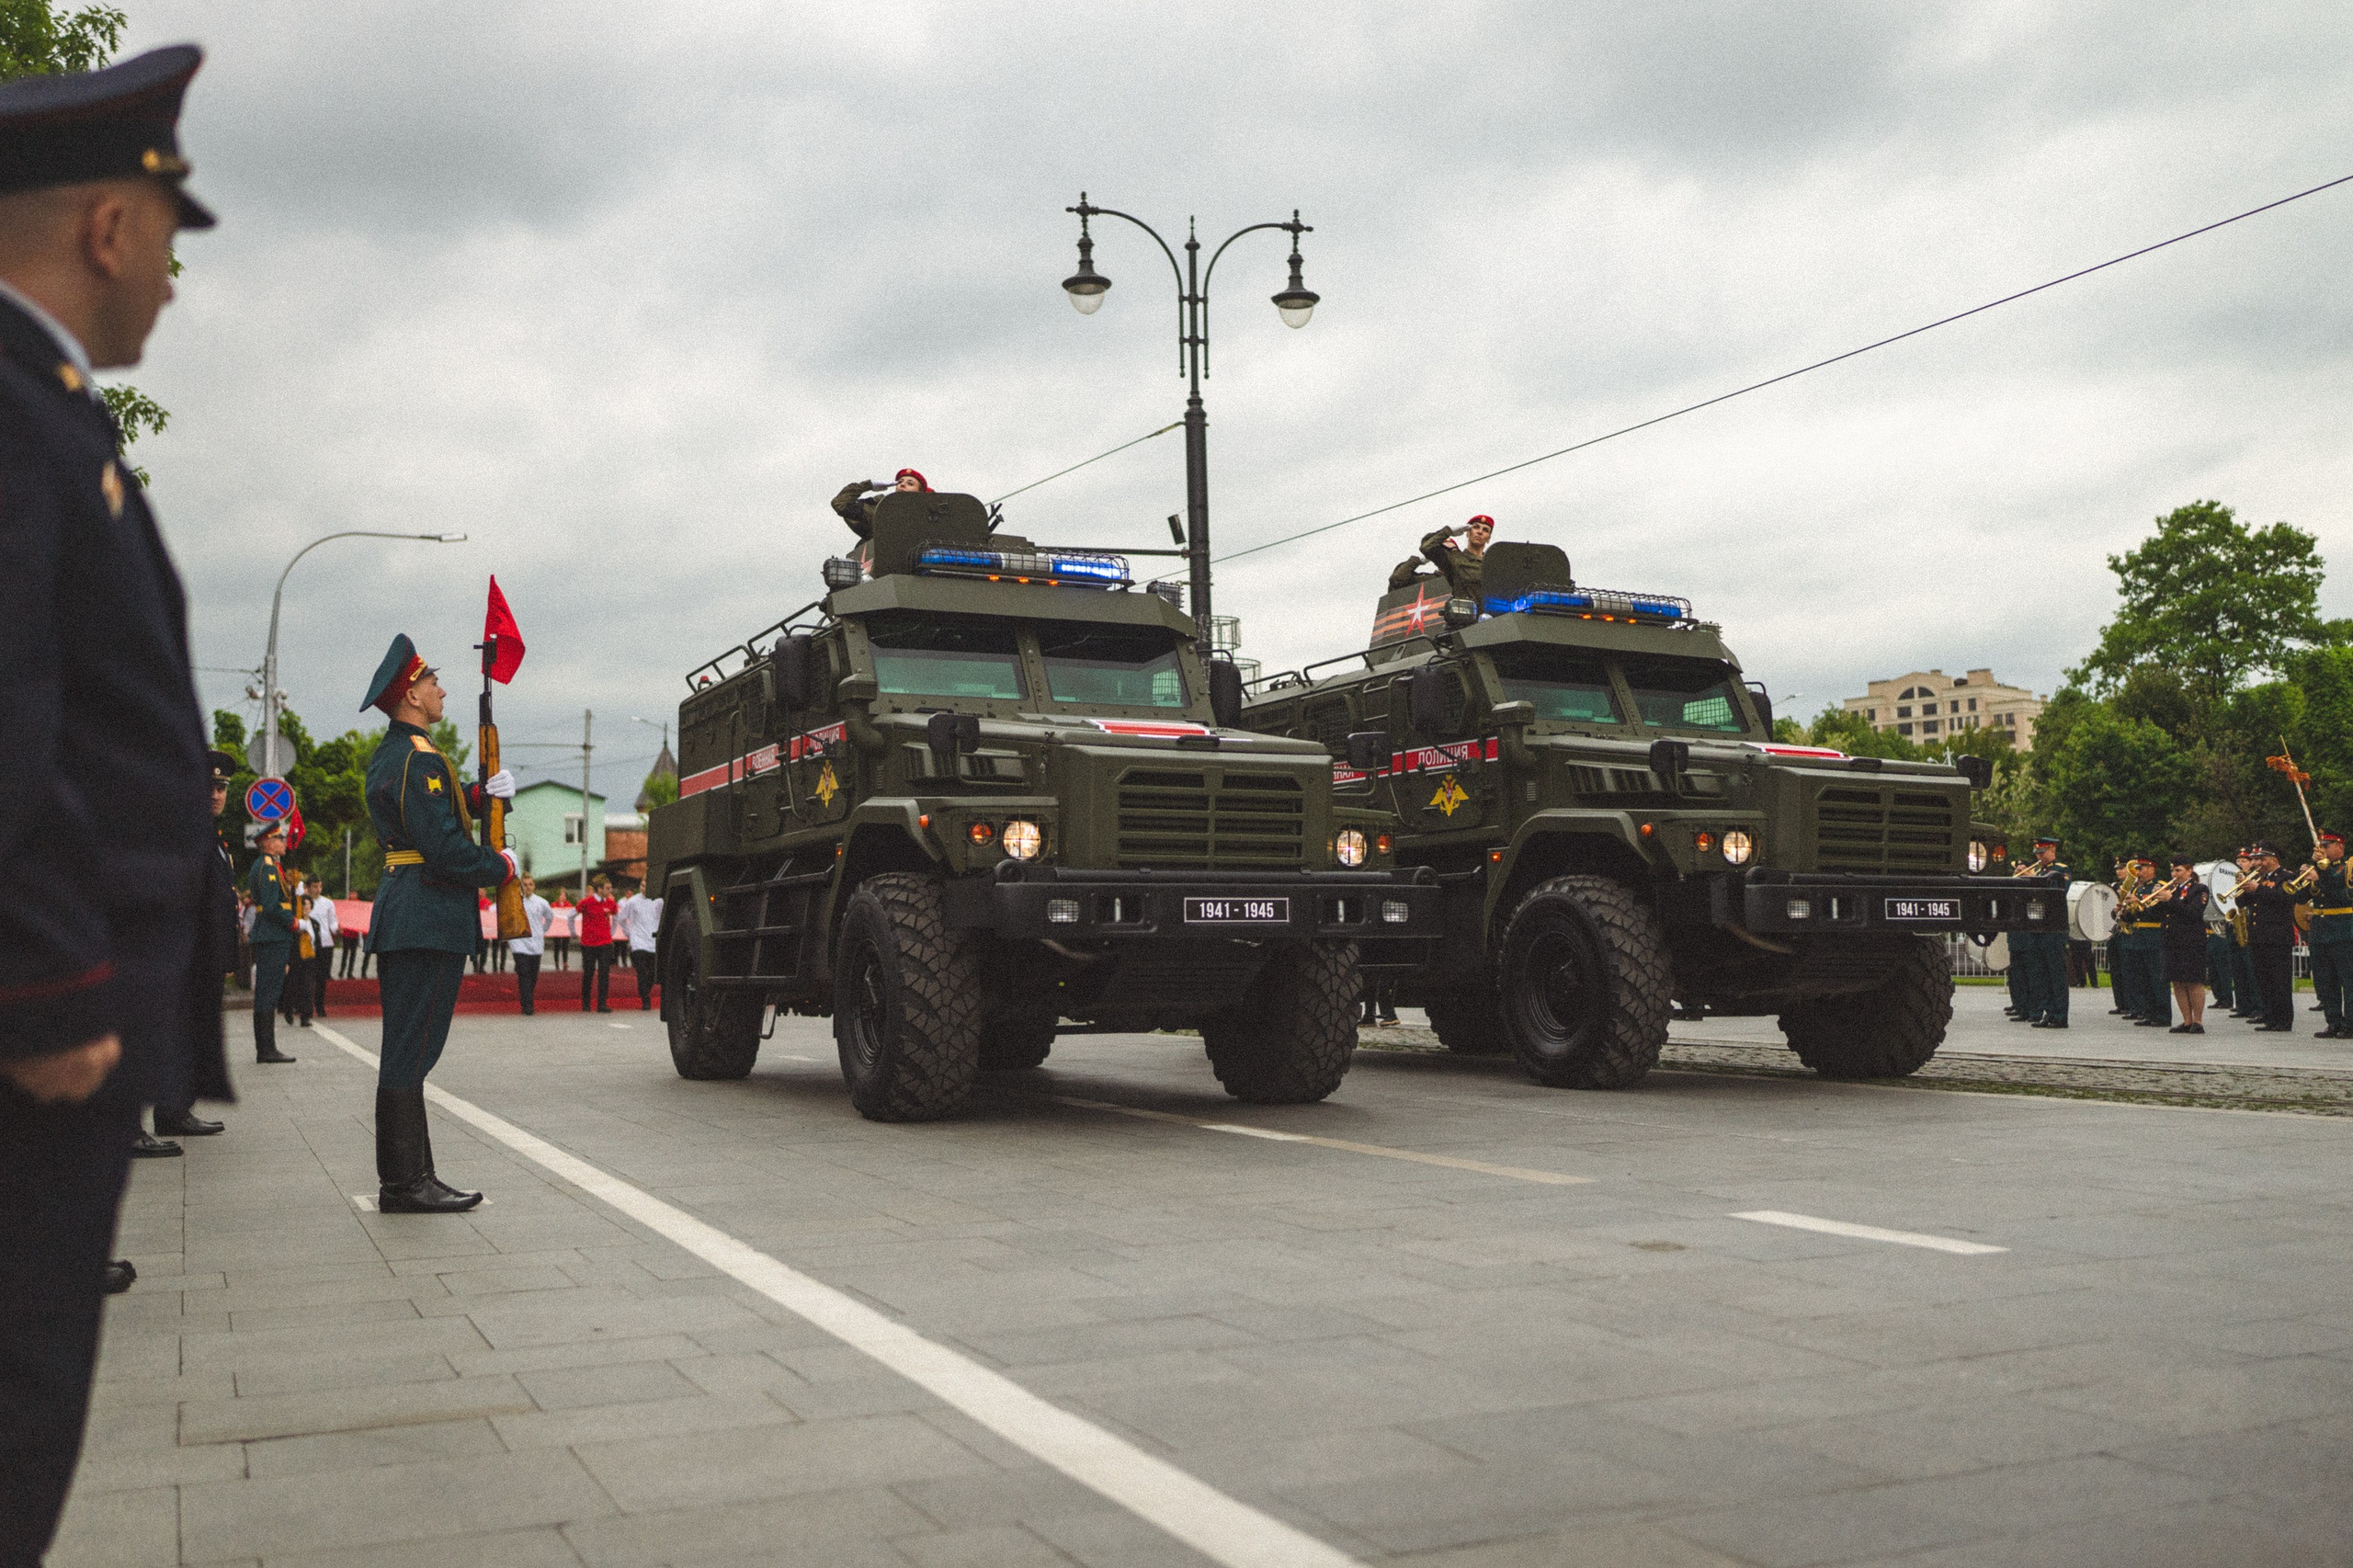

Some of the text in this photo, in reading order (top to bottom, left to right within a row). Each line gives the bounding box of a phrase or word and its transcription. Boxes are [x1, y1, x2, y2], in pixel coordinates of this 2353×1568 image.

[1199, 902, 1230, 918] 1941
[1244, 902, 1274, 918] 1945
[1896, 902, 1918, 916] 1941
[1927, 903, 1949, 916] 1945
